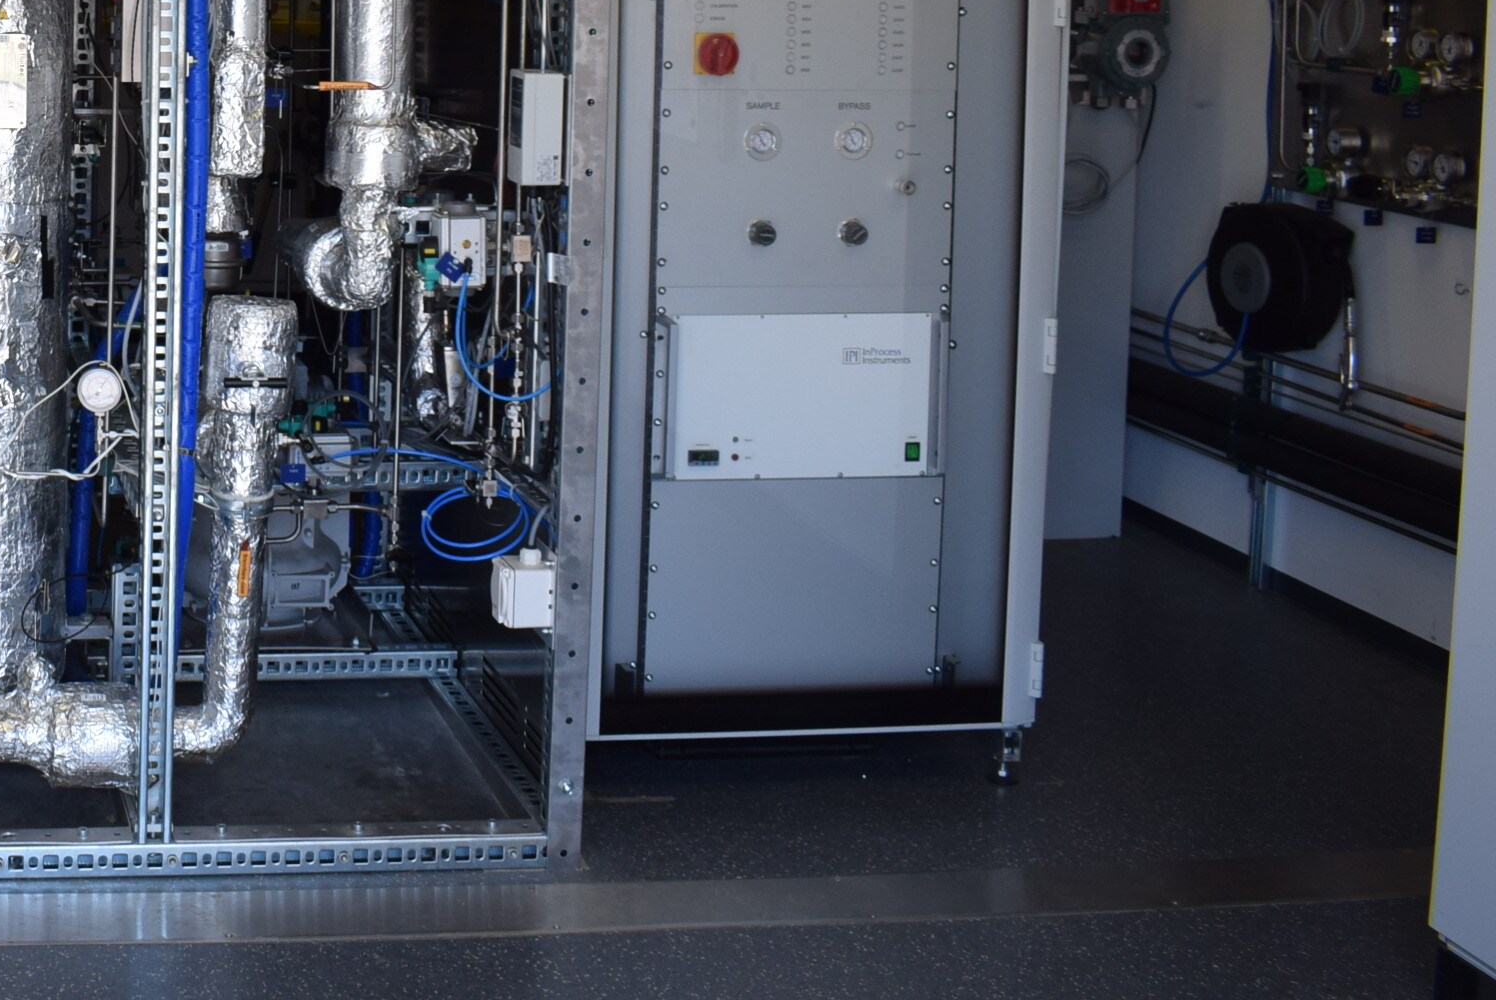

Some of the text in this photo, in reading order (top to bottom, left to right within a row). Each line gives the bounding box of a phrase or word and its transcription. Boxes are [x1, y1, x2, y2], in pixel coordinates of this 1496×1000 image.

[745, 102, 780, 110] SAMPLE
[838, 102, 871, 110] BYPASS
[862, 348, 901, 357] InProcess
[862, 357, 911, 365] Instruments
